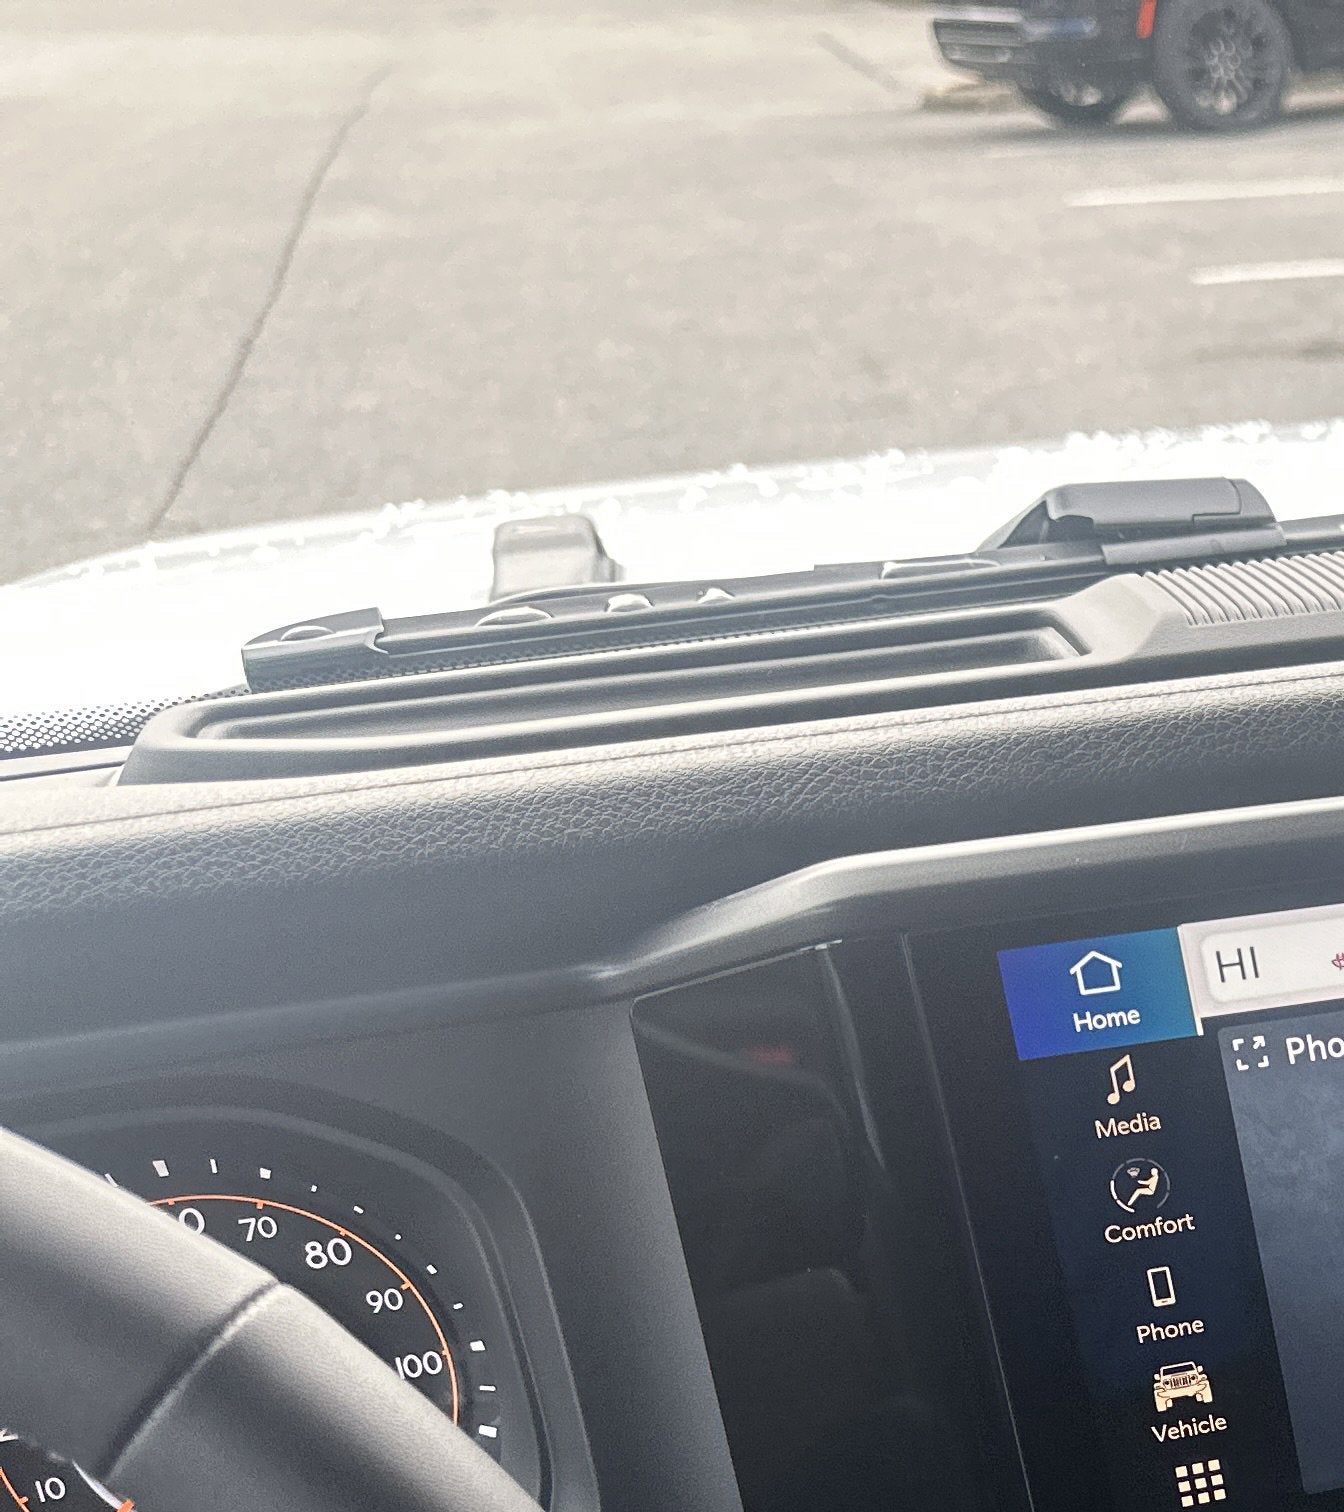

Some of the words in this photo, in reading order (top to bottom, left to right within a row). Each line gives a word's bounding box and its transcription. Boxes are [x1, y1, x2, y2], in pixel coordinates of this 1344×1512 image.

[1216, 945, 1260, 985] HI
[1073, 1007, 1141, 1032] Home
[1095, 1112, 1161, 1139] Media
[238, 1216, 278, 1242] 70
[1104, 1213, 1196, 1244] Comfort
[304, 1236, 352, 1269] 80
[366, 1287, 403, 1314] 90
[1136, 1317, 1205, 1344] Phone
[395, 1350, 442, 1379] 100
[1151, 1414, 1227, 1443] Vehicle
[35, 1477, 66, 1503] 10
